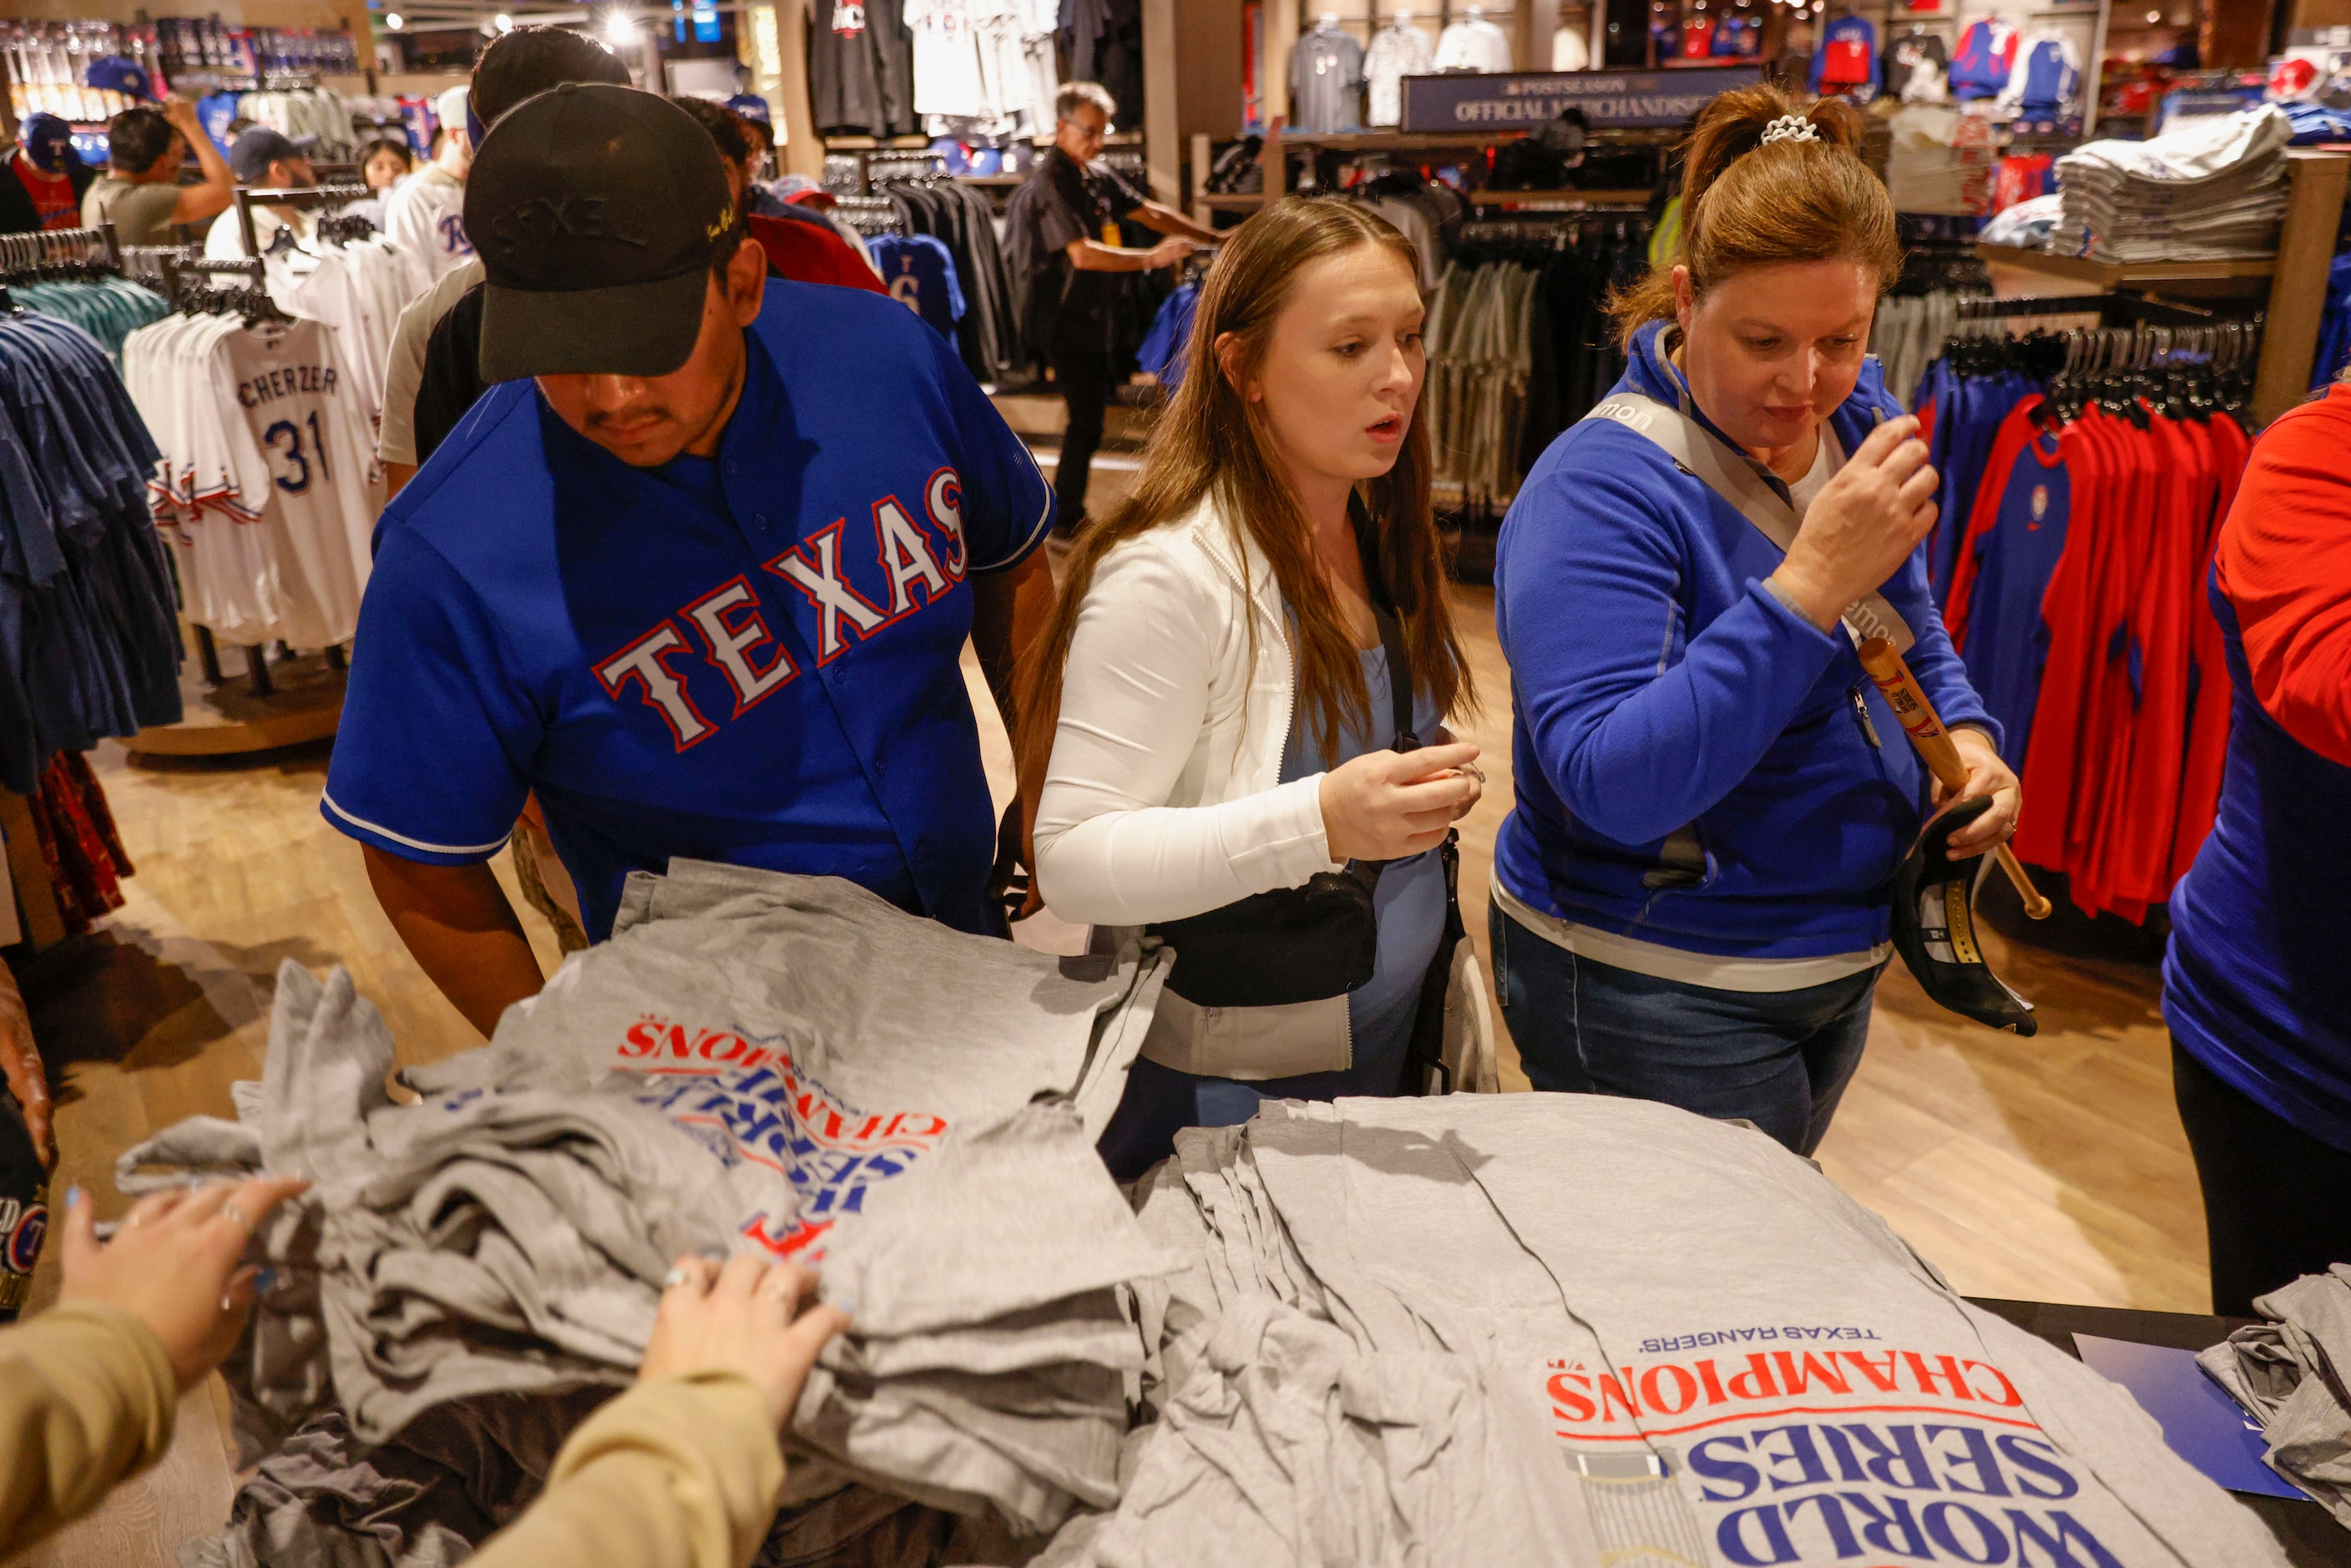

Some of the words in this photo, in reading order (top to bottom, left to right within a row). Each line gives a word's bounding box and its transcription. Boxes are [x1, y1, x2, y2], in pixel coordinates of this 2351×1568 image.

[1454, 99, 1545, 122] OFFICIAL
[264, 410, 331, 496] 31
[589, 466, 968, 754] TEXAS
[1642, 1327, 1778, 1353] RANGERS
[1782, 1326, 1882, 1341] TEXAS
[1545, 1349, 2024, 1424] CHAMPIONS
[1687, 1423, 2081, 1503] SERIES
[1716, 1491, 2126, 1568] WORLD
